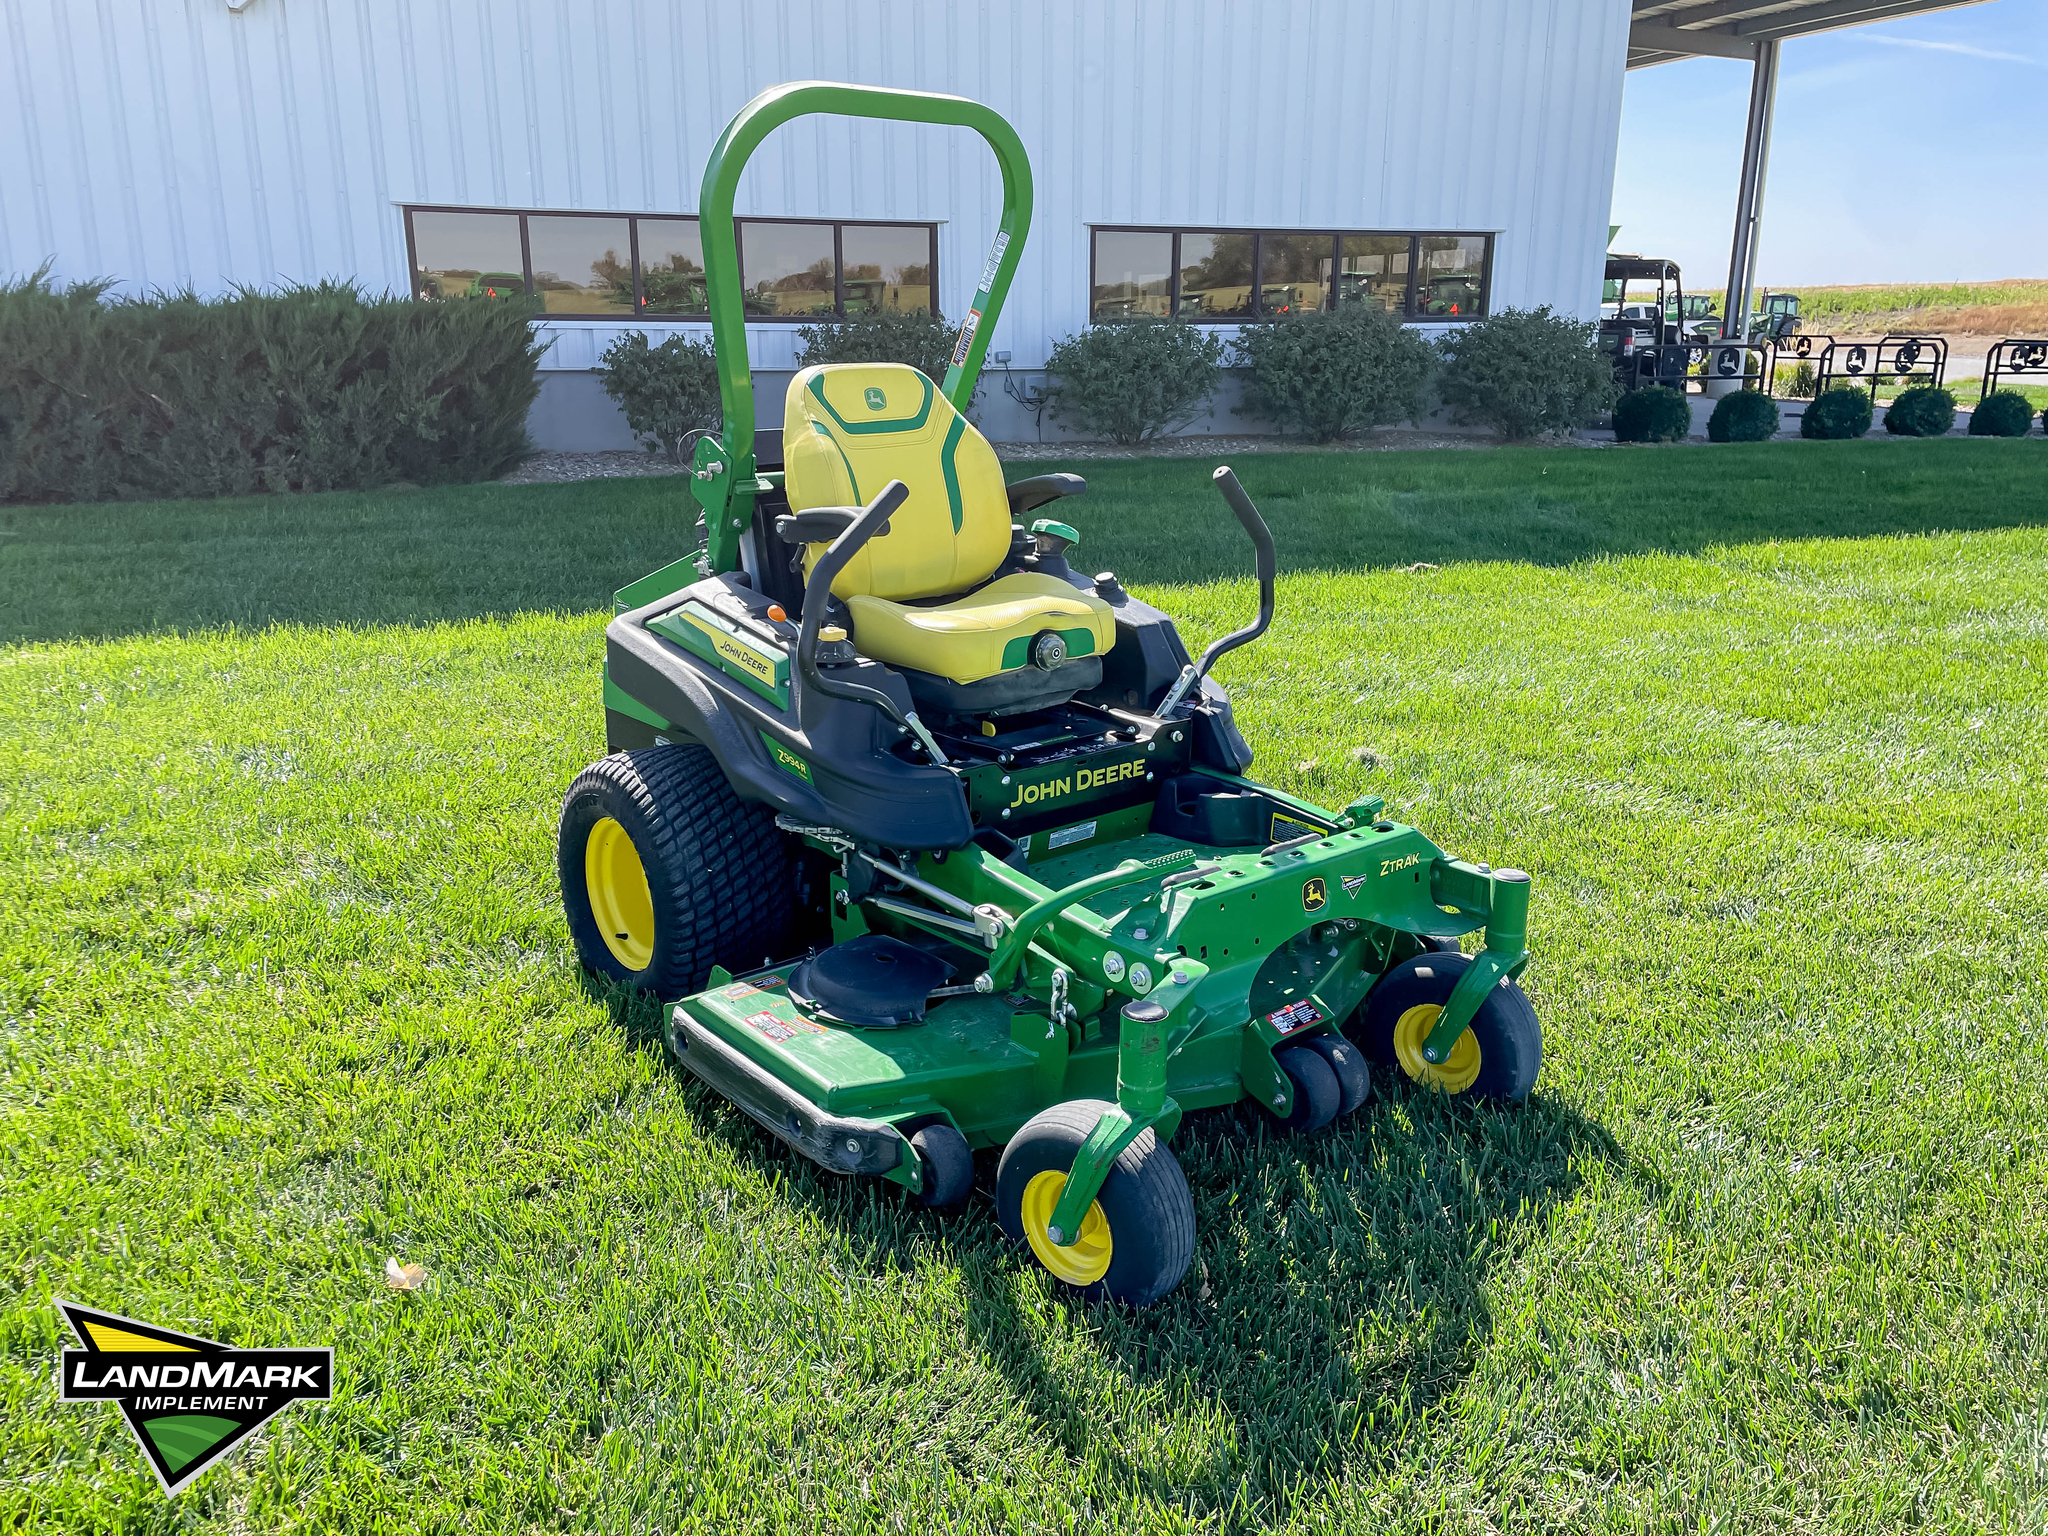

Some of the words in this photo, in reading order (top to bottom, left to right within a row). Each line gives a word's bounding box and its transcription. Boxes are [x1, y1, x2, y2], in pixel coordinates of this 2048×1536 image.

[720, 640, 742, 659] JOHN
[741, 651, 769, 675] DEERE
[777, 748, 807, 774] Z994R
[1010, 776, 1071, 808] JOHN
[1076, 758, 1146, 792] DEERE
[1379, 852, 1420, 877] ZTRAK
